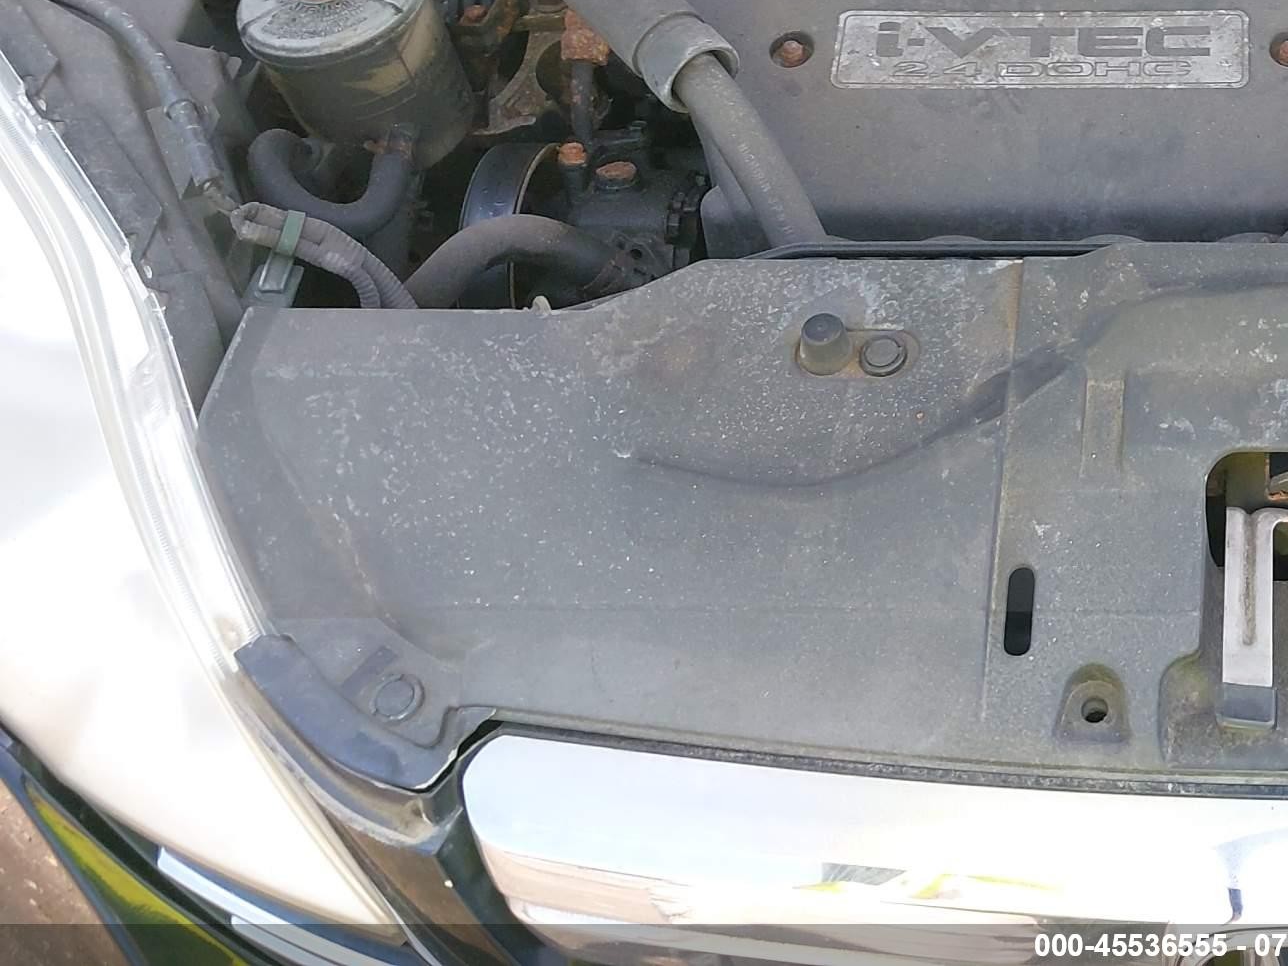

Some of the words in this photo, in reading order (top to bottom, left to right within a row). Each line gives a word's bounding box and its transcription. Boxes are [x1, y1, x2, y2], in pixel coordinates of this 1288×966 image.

[876, 21, 1211, 58] i-VTEC
[892, 61, 982, 78] 2.4
[998, 61, 1192, 78] DOHC
